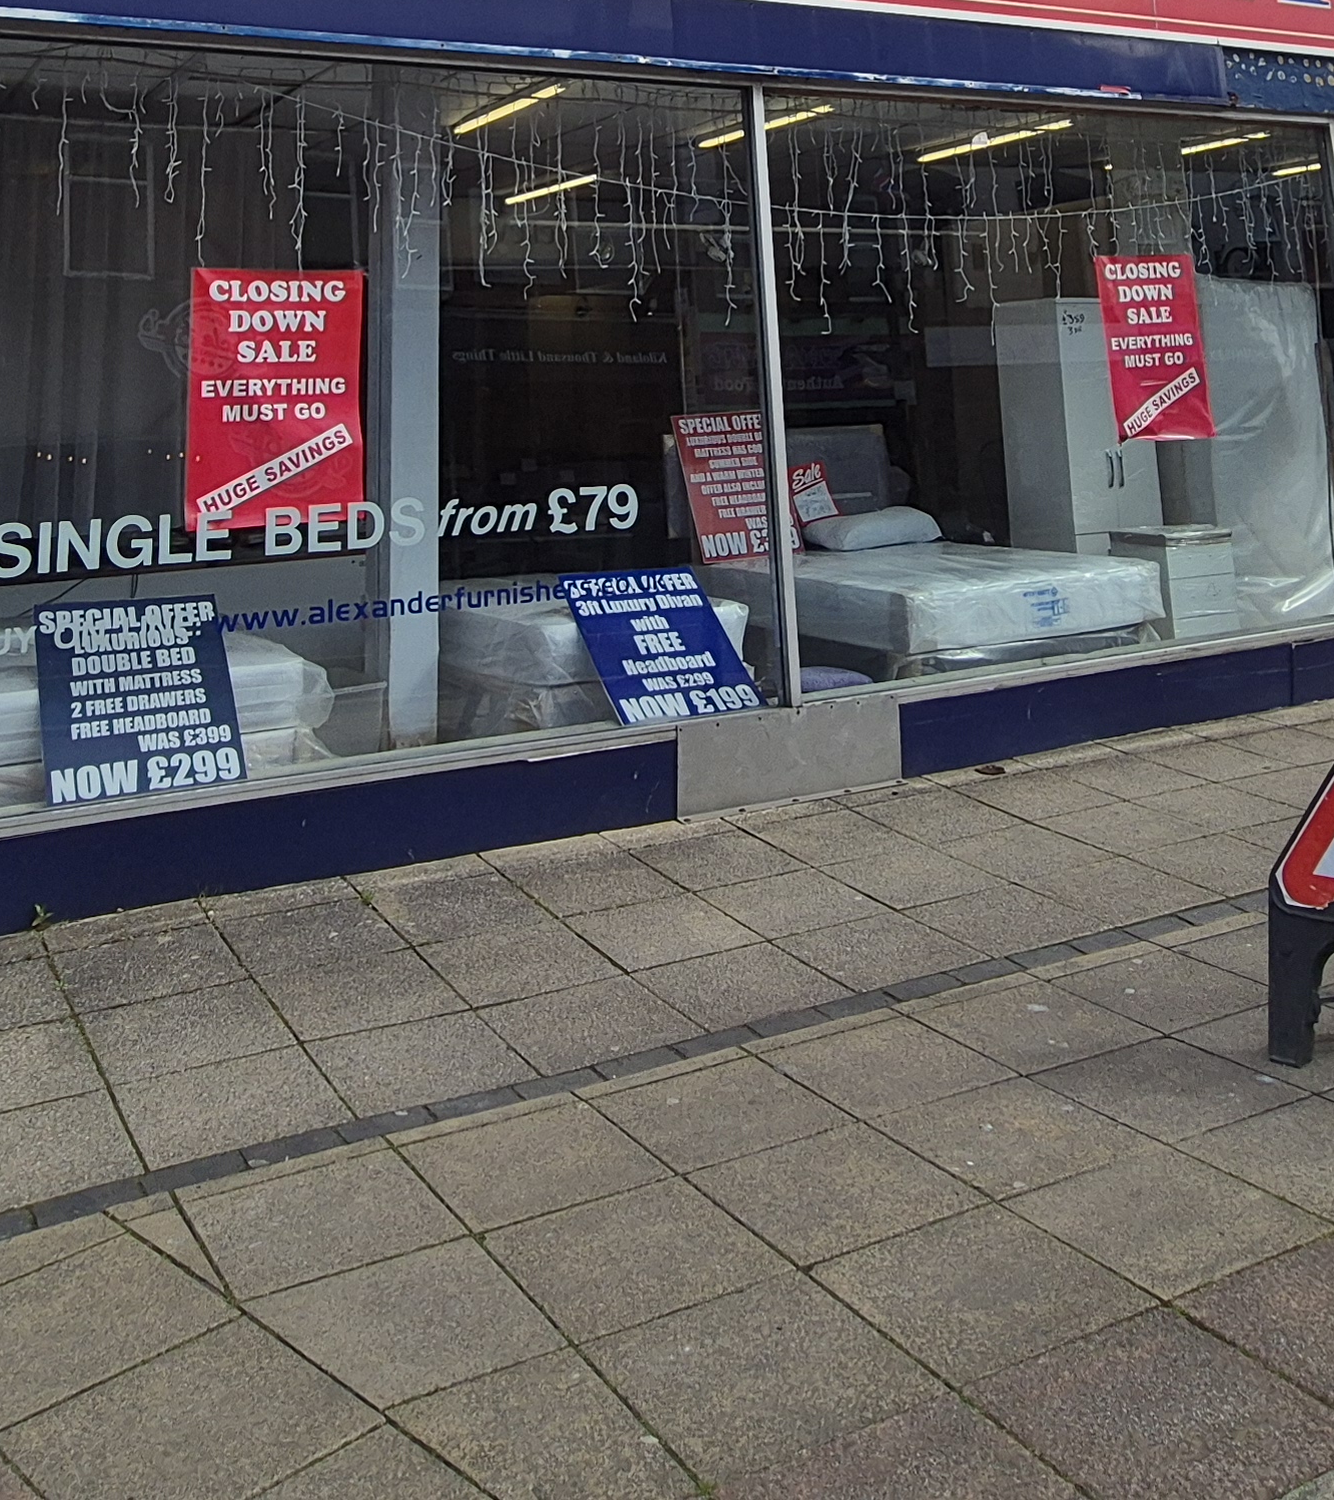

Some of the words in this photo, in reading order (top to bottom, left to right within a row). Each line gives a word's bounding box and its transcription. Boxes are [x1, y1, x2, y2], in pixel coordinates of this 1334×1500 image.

[1105, 262, 1181, 280] CLOSING
[209, 280, 346, 302] CLOSING
[1118, 284, 1173, 302] DOWN
[229, 310, 326, 332] DOWN
[1127, 307, 1173, 324] SALE
[237, 340, 317, 363] SALE
[1111, 333, 1193, 350] EVERYTHING
[1124, 353, 1161, 368] MUST
[1164, 352, 1183, 365] GO
[201, 377, 346, 398] EVERYTHING
[222, 404, 287, 422] MUST
[294, 402, 326, 420] GO
[1127, 406, 1153, 436] HUGE
[1152, 372, 1197, 410] SAVINGS
[678, 416, 732, 434] SPECIAL
[732, 413, 761, 430] OFFE
[203, 475, 260, 513] HUGE
[264, 429, 348, 483] SAVINGS
[792, 463, 821, 490] Sale
[265, 496, 426, 556] BEDS
[436, 498, 537, 540] from
[546, 483, 640, 535] £79
[701, 531, 747, 559] NOW
[575, 599, 603, 616] 3ft
[602, 595, 657, 614] Luxury
[658, 593, 703, 610] Divan
[38, 604, 140, 635] SPECIAL
[142, 601, 215, 628] OFFER
[630, 614, 670, 632] with
[633, 631, 686, 655] FREE
[71, 650, 153, 676] DOUBLE
[156, 646, 196, 667] BED
[621, 651, 716, 675] Headboard
[70, 678, 116, 697] WITH
[118, 668, 203, 692] MATTRESS
[642, 676, 677, 692] WAS
[677, 671, 714, 688] £299
[71, 701, 82, 718] 2
[85, 697, 124, 717] FREE
[127, 687, 207, 712] DRAWERS
[619, 691, 691, 723] NOW
[689, 684, 760, 714] £199
[70, 721, 111, 741] FREE
[113, 708, 211, 734] HEADBOARD
[137, 731, 181, 753] WAS
[183, 724, 232, 746] £399
[50, 759, 138, 804] NOW
[146, 747, 241, 791] £299
